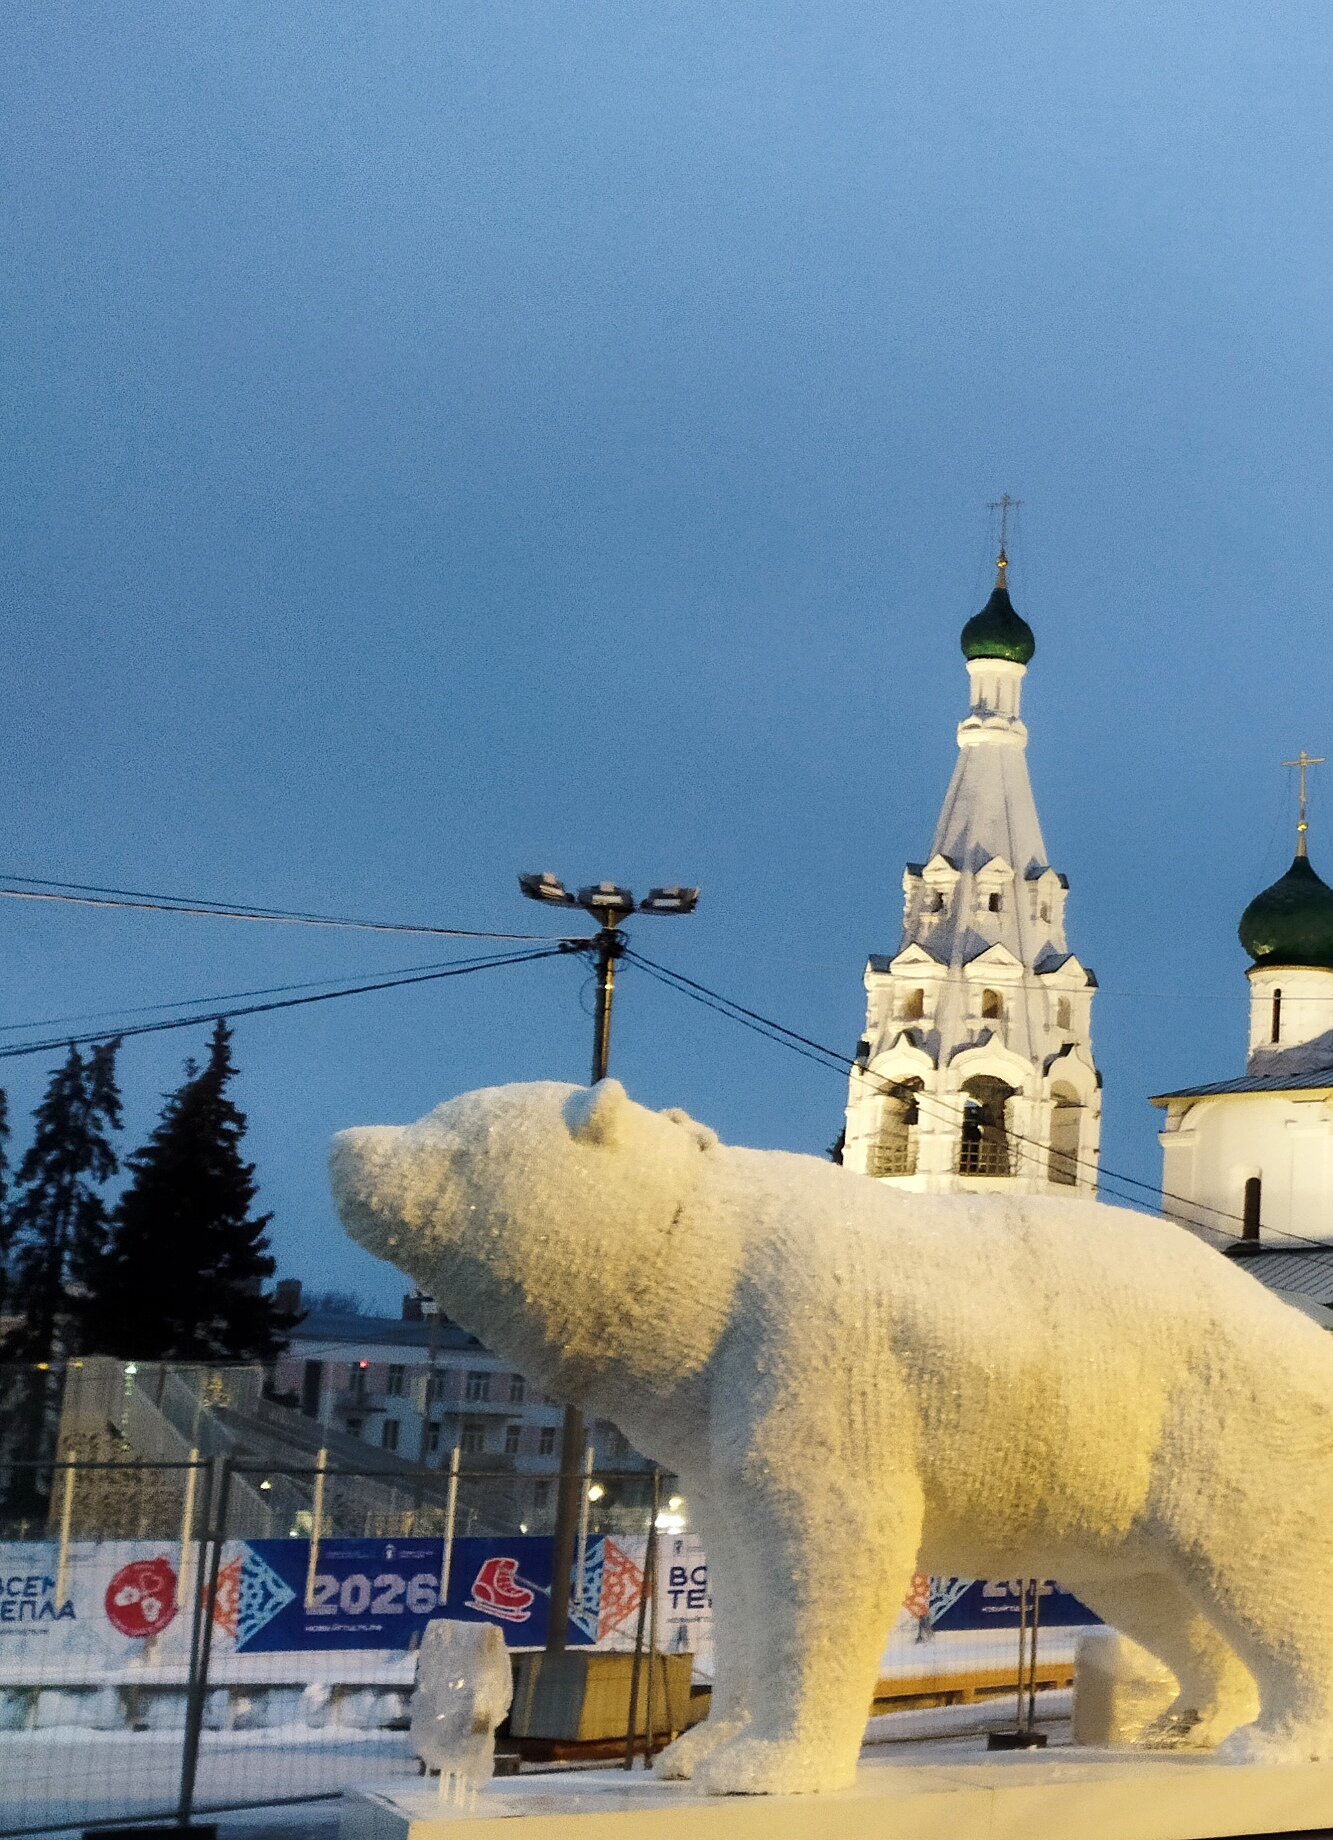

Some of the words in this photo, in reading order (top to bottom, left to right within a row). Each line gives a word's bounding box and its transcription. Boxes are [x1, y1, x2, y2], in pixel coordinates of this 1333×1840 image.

[669, 1566, 708, 1586] ВС
[305, 1573, 439, 1615] 2026
[0, 1600, 76, 1620] ЕПЛА
